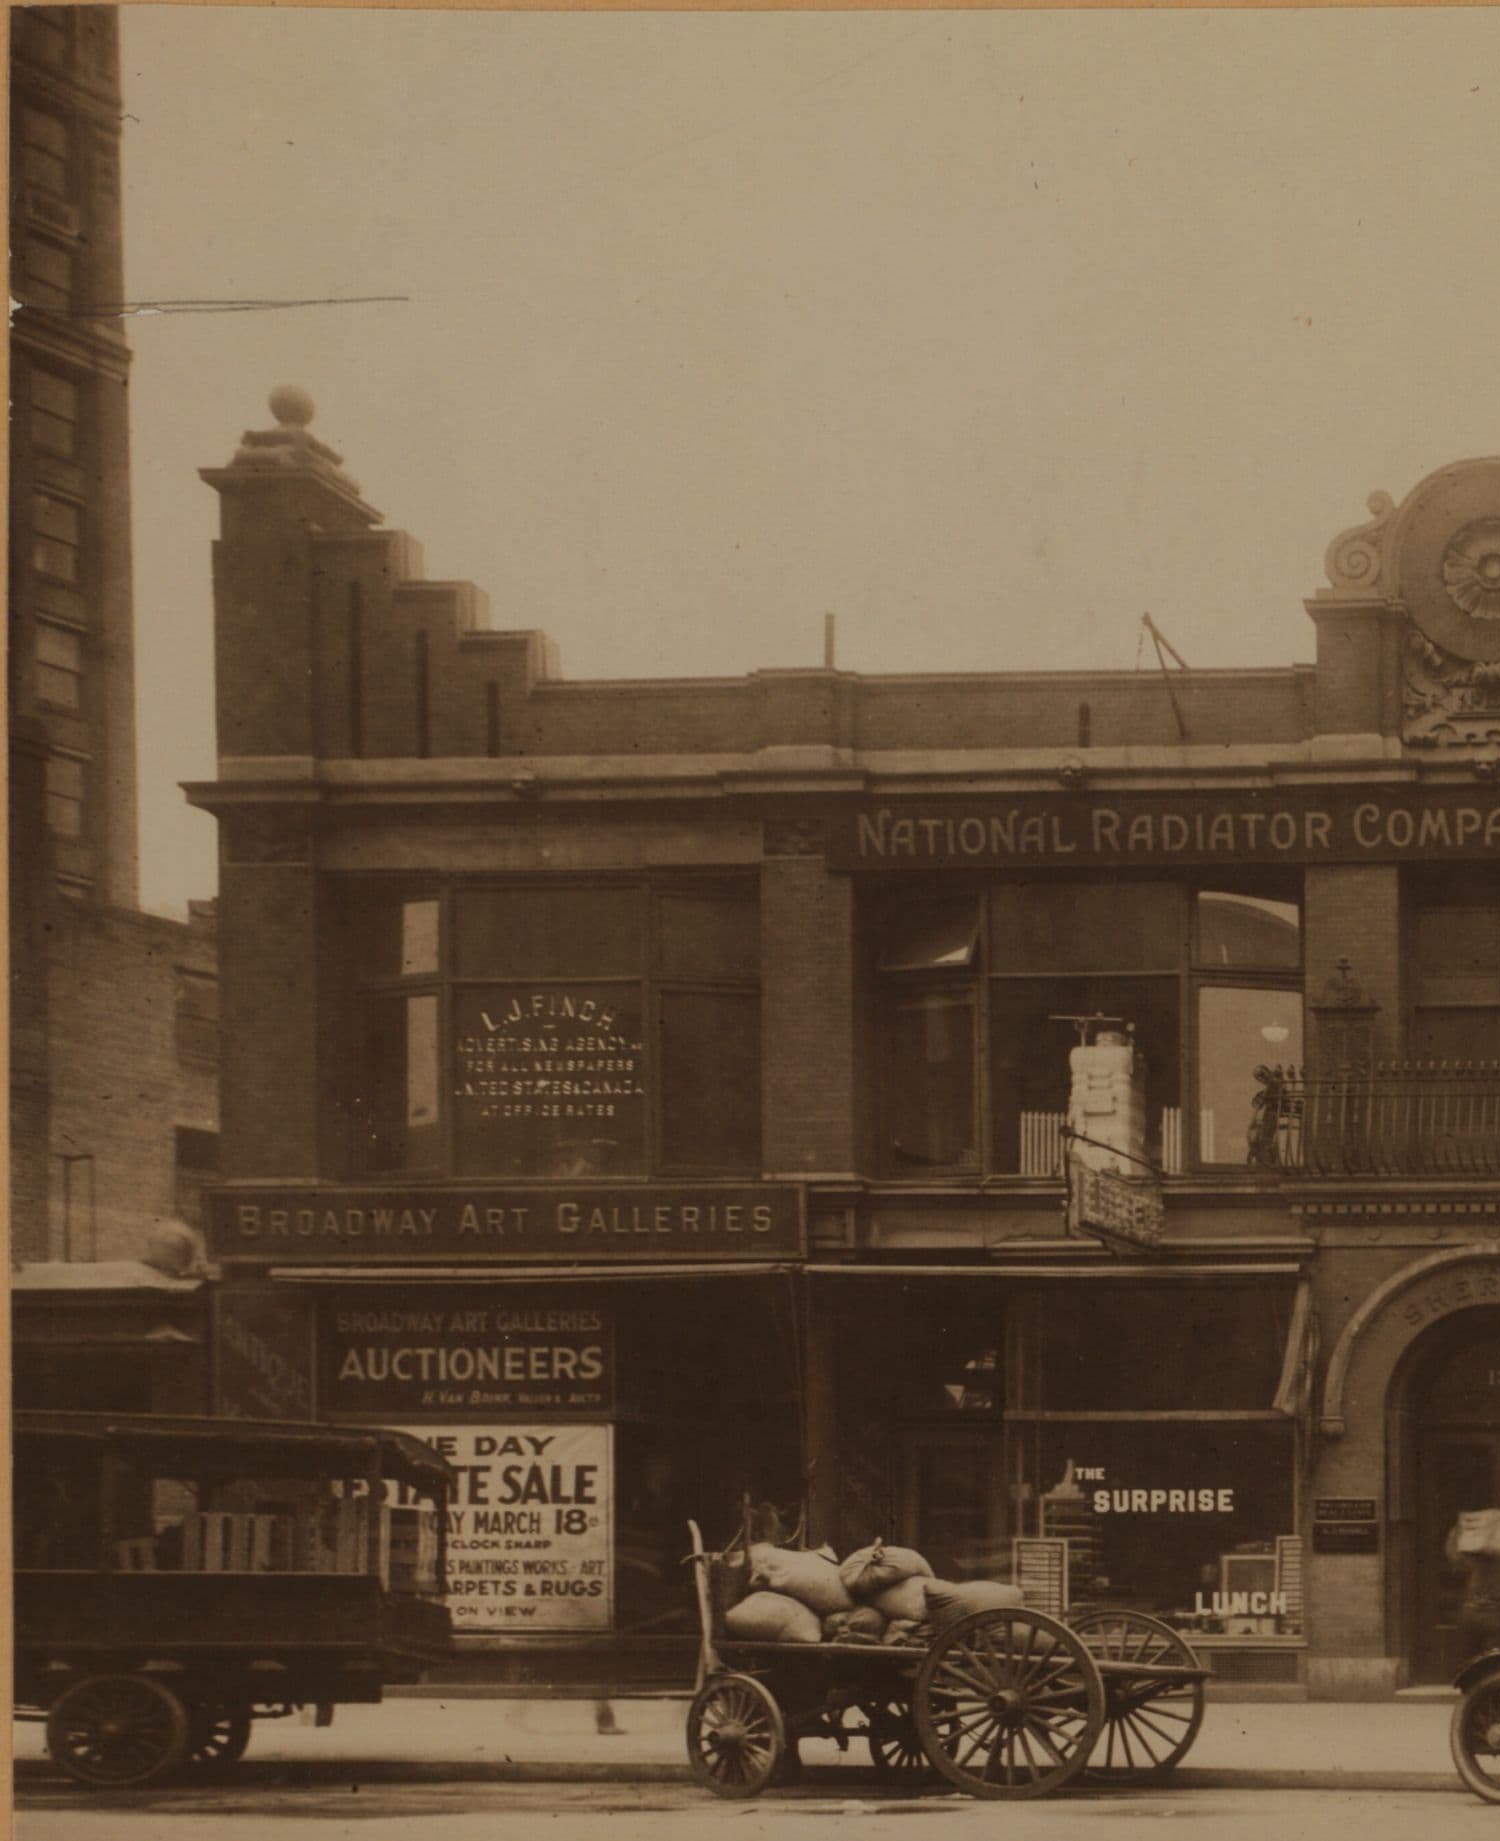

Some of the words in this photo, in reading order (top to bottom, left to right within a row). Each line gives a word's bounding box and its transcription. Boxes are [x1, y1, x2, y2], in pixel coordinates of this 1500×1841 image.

[856, 806, 1078, 857] NATIONAL
[1091, 807, 1332, 855] RADIATOR
[237, 1203, 438, 1238] BROADWAY
[458, 1203, 529, 1235] ART
[555, 1202, 773, 1234] GALLERIES
[337, 1313, 443, 1333] BROADWAY
[449, 1311, 488, 1332] ART
[495, 1311, 601, 1331] GALLERIES
[338, 1345, 604, 1382] AUCTIONEERS
[475, 1436, 556, 1456] DAY
[498, 1464, 599, 1505] SALE
[1074, 1468, 1106, 1480] THE
[1093, 1490, 1235, 1513] SURPRISE
[473, 1510, 542, 1535] MARCH
[451, 1540, 501, 1549] CLOCK
[504, 1540, 552, 1549] SHARP
[459, 1560, 519, 1575] PAINTINGS
[522, 1560, 569, 1575] WORKS
[579, 1560, 606, 1575] ART
[524, 1583, 537, 1596] &
[540, 1579, 604, 1596] RUGS
[456, 1605, 479, 1616] ON
[486, 1606, 537, 1616] VIEW
[1195, 1591, 1287, 1615] LUNCH
